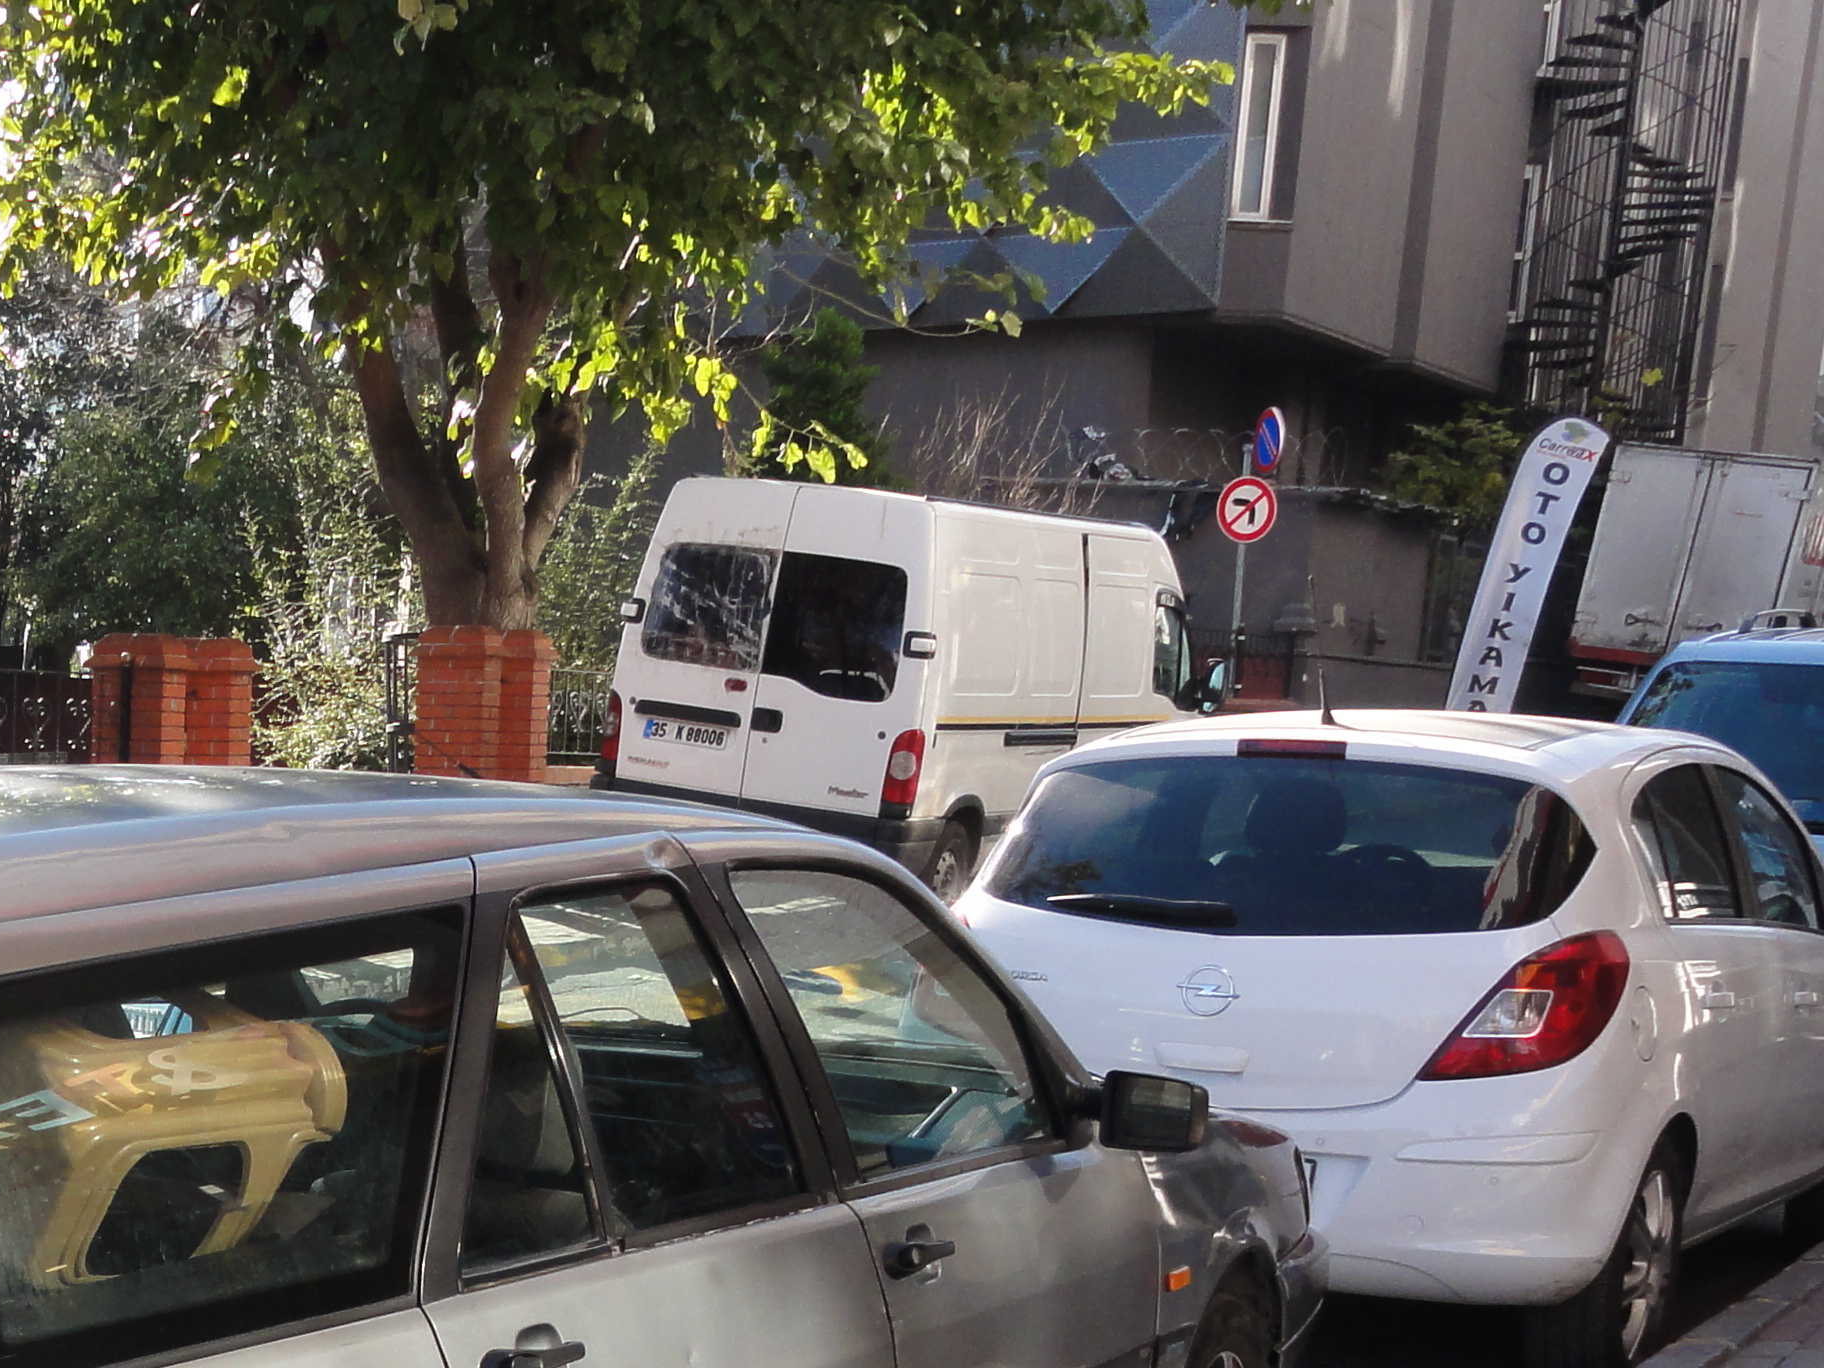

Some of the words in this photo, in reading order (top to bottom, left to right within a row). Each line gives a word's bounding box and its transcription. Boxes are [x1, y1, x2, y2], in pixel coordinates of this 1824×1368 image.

[1521, 462, 1570, 545] OTO
[1466, 563, 1532, 712] YIKAMA
[651, 723, 668, 737] 35
[675, 725, 685, 740] K
[686, 727, 725, 746] 88006
